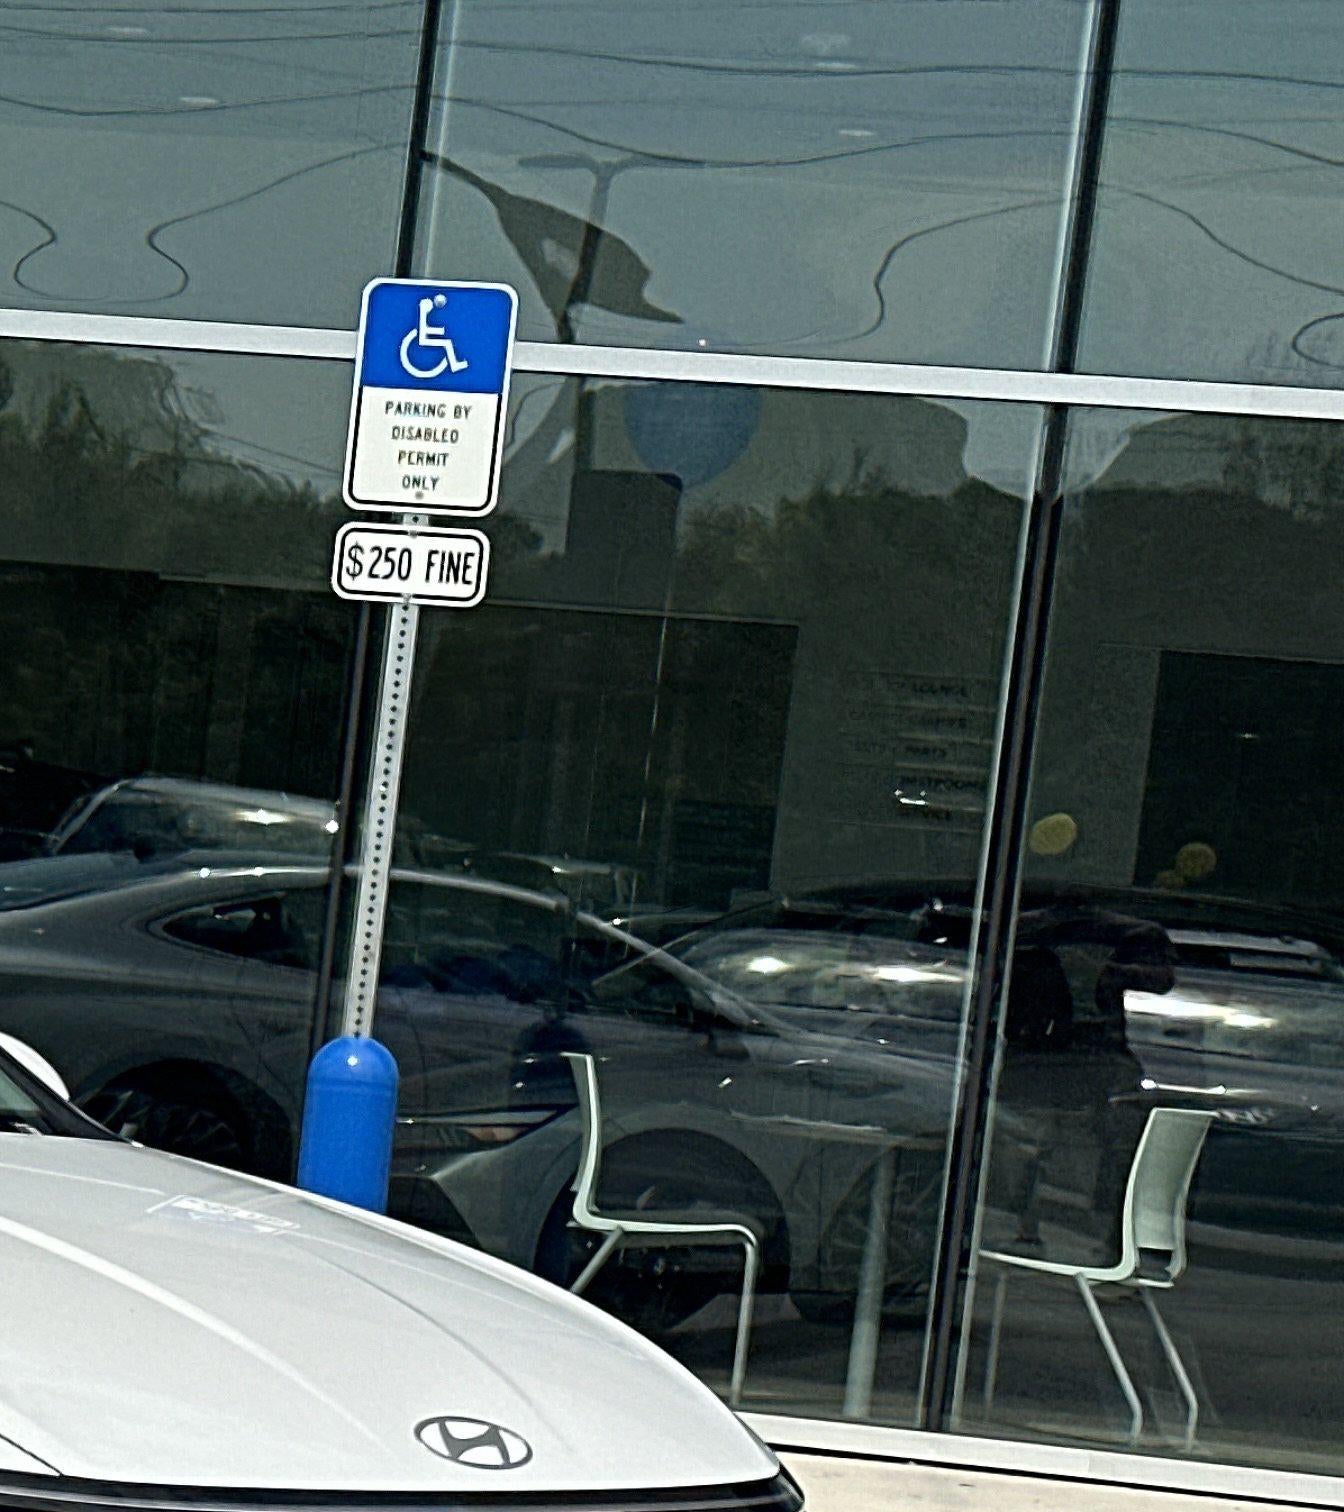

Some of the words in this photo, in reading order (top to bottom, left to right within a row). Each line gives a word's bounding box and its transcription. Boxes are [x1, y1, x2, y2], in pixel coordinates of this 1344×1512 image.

[385, 400, 446, 418] PARKING
[453, 404, 472, 419] BY
[391, 425, 459, 444] DISABLED
[398, 449, 450, 467] PERMIT
[402, 474, 440, 491] ONLY
[346, 540, 412, 581] $250
[425, 549, 475, 585] FINE
